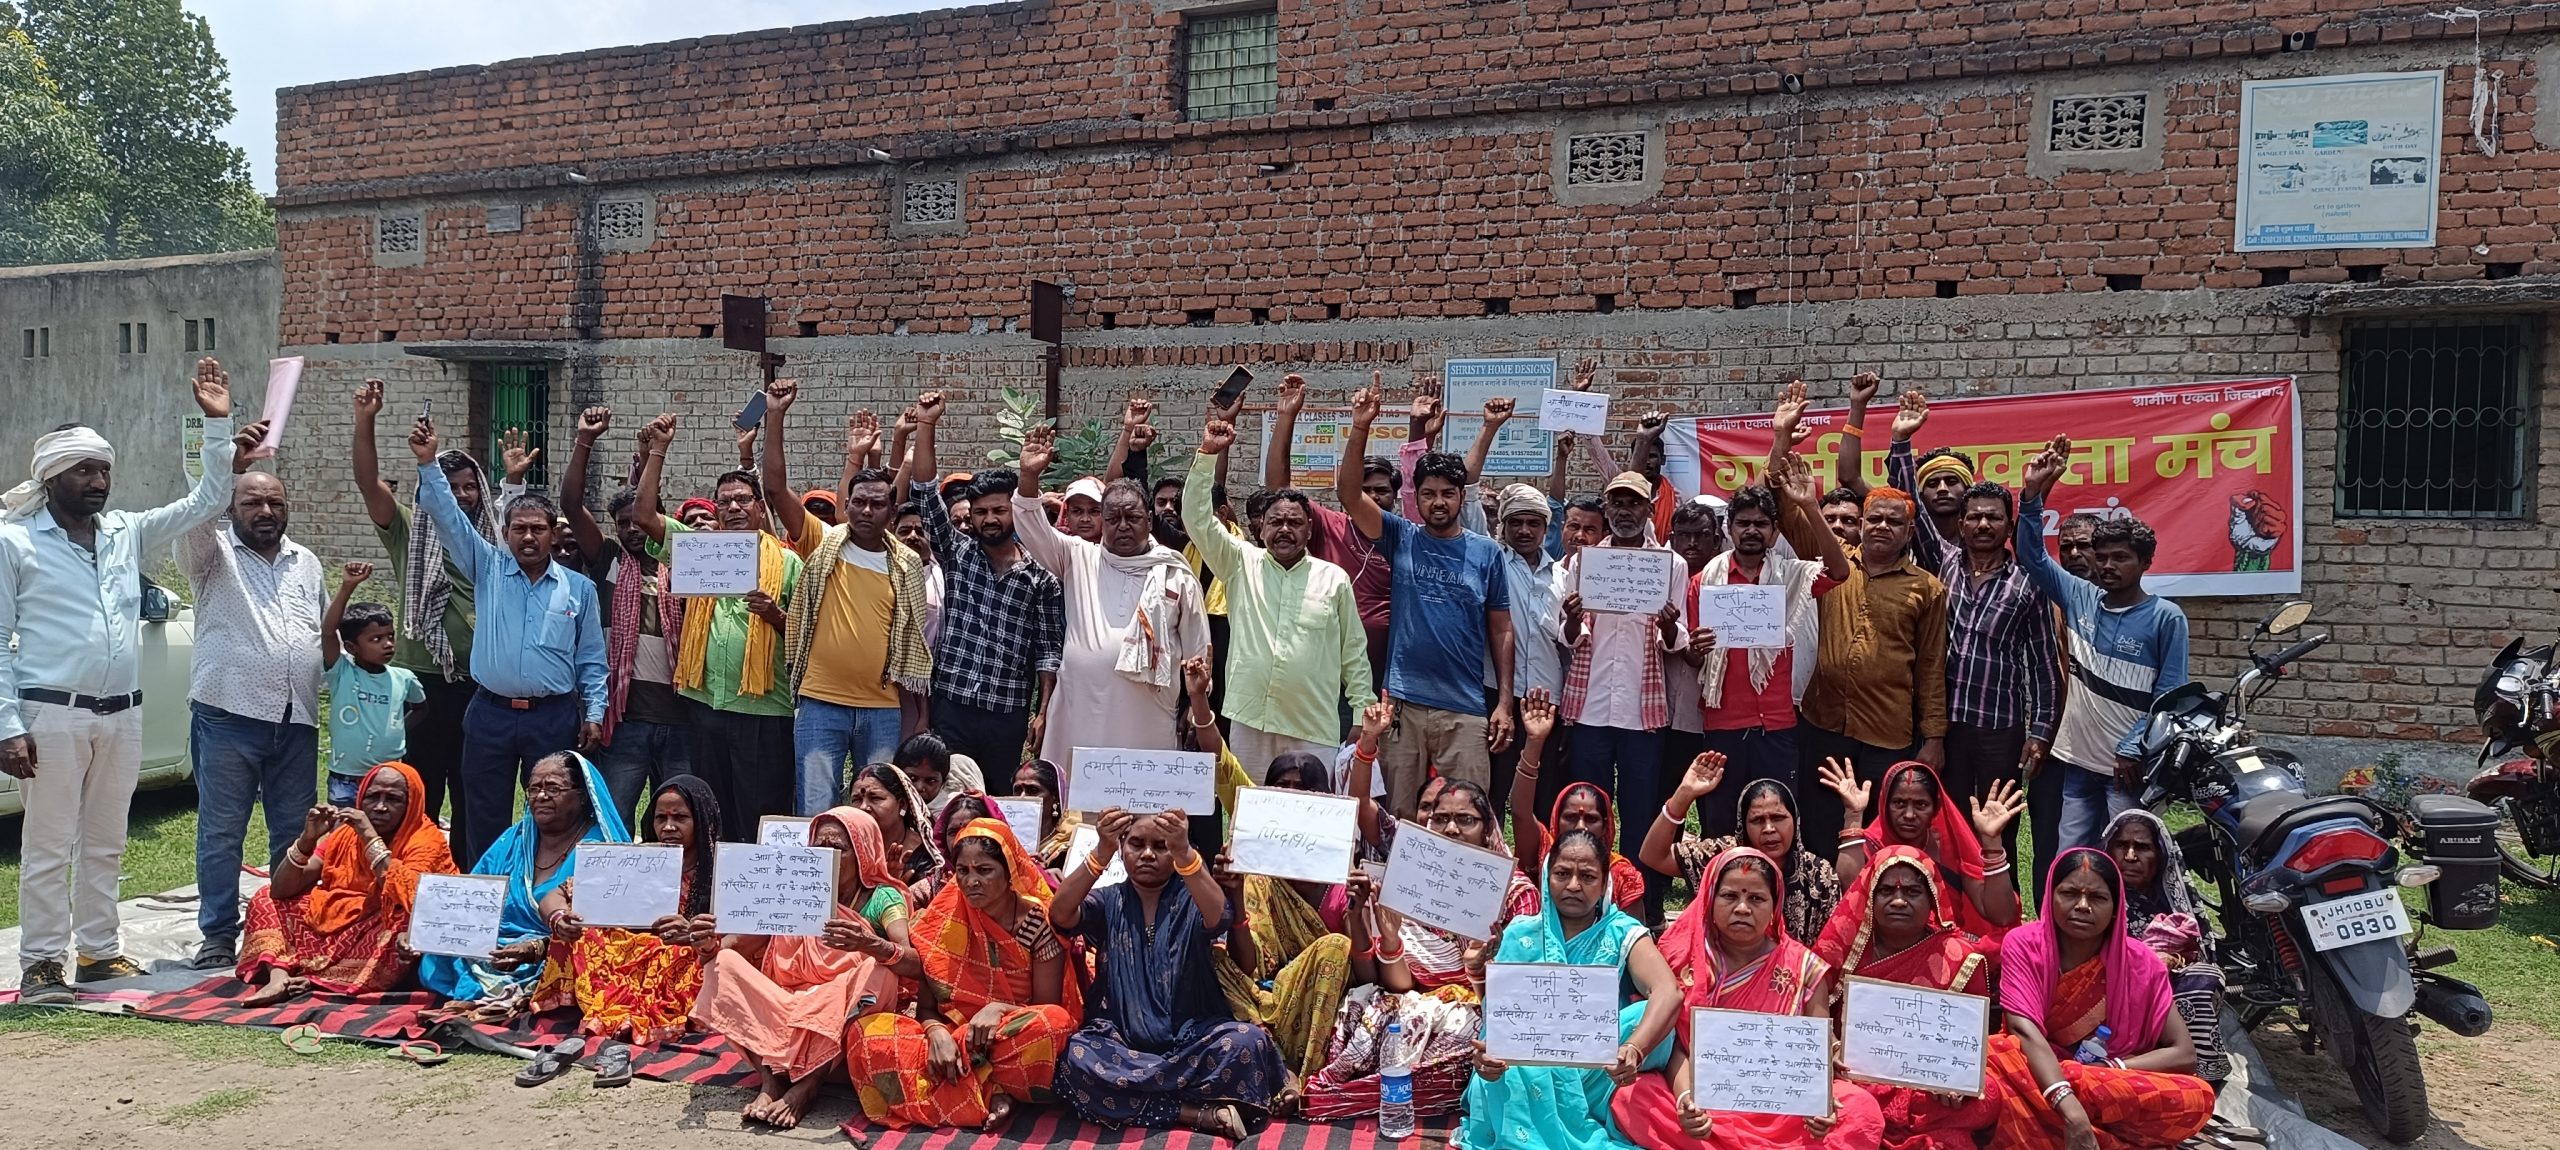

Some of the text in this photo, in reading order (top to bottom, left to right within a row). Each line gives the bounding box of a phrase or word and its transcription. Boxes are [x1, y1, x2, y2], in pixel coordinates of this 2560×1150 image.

[1450, 363, 1551, 375] SHRISTY HOME DESIGNS
[2132, 385, 2285, 407] ग्रामीण एकता जिन्दाबाद
[1304, 412, 1336, 422] CLASSES
[1703, 419, 1740, 432] ग्रामीण
[1304, 435, 1333, 444] CTET
[2152, 412, 2278, 479] मंच
[1083, 755, 1128, 779] हमारी
[1193, 761, 1213, 775] करो
[749, 853, 774, 862] आग
[789, 848, 822, 865] बचाओ
[749, 867, 771, 875] आग
[792, 867, 823, 877] बचाओ
[792, 895, 826, 909] बचाओ
[2327, 897, 2384, 917] JH10BU
[2336, 915, 2397, 940] 0830
[1525, 969, 1588, 993] पानी दो
[1530, 988, 1588, 1008] पानी दो
[1890, 993, 1959, 1016] पानी दो
[1728, 1017, 1819, 1036] आग से बचाओ
[1883, 1012, 1956, 1032] पानी दो
[1732, 1035, 1820, 1052] आग से बचाओ
[1902, 1031, 1914, 1039] 12
[1951, 1036, 1972, 1051] पानी
[1737, 1067, 1814, 1084] आग से बचाओ
[1732, 1093, 1787, 1111] जिन्दाबाद
